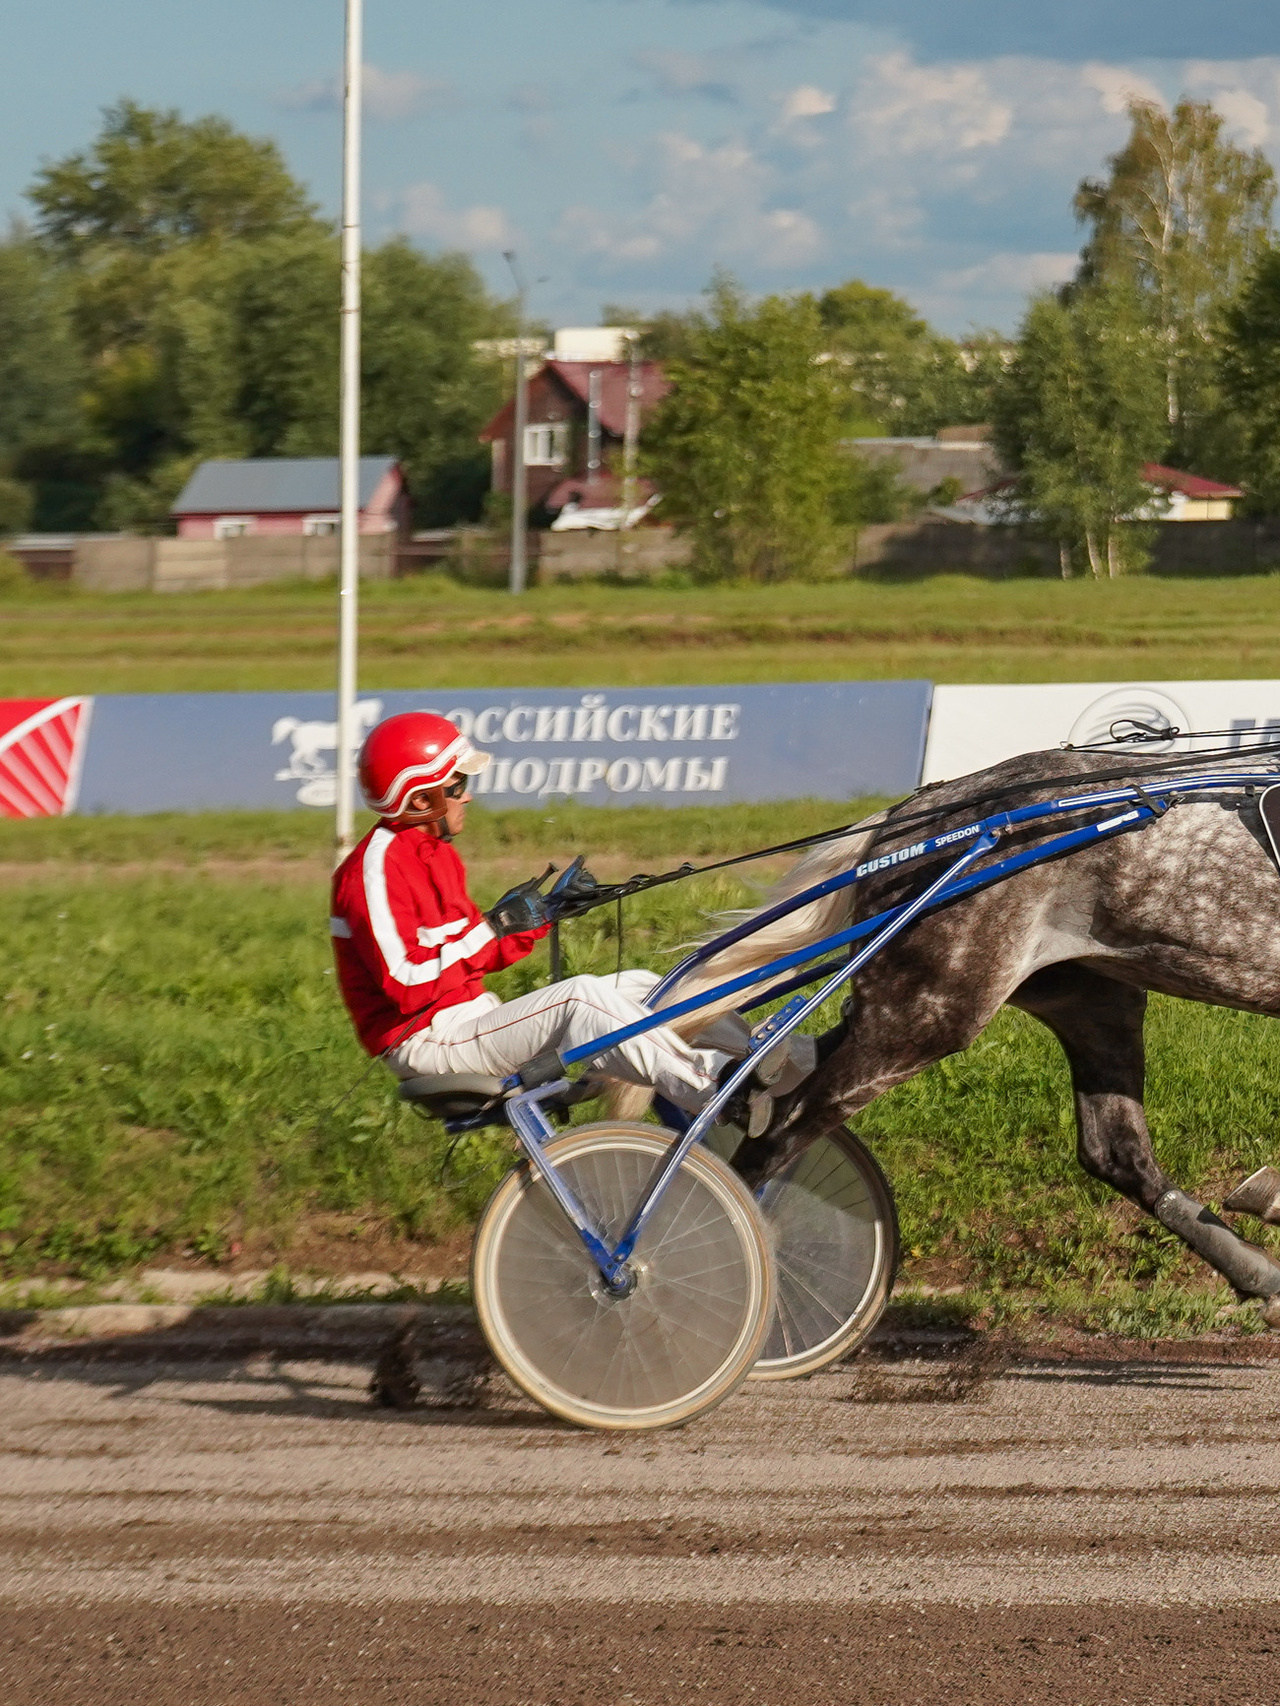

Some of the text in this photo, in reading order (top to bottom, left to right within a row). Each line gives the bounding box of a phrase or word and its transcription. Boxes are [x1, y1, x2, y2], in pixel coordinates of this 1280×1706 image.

[424, 694, 740, 743] ОССИЙСКИЕ
[466, 757, 730, 798] ПОДРОМЫ
[856, 824, 980, 878] CUSTOM SPEEDON
